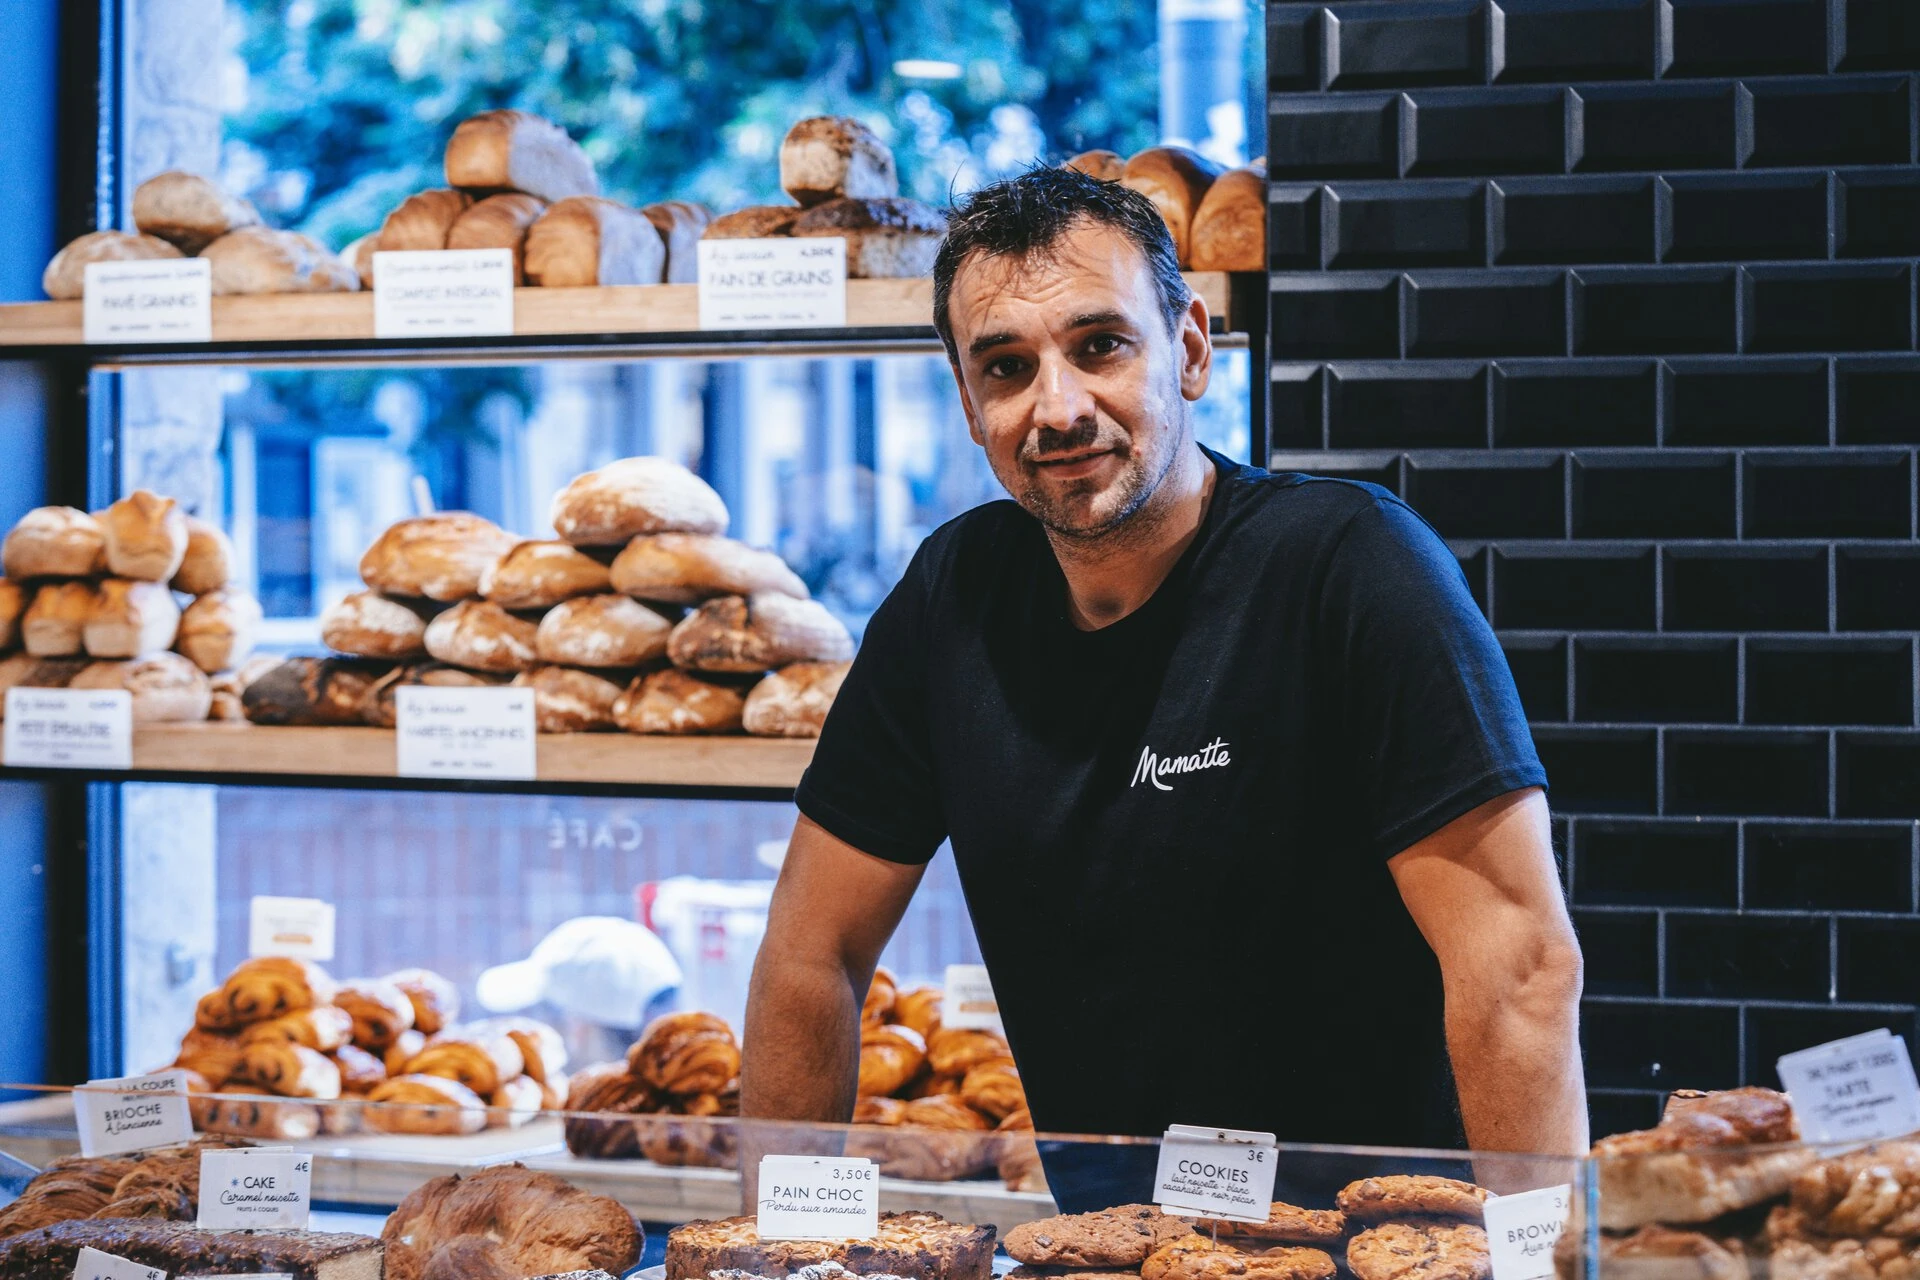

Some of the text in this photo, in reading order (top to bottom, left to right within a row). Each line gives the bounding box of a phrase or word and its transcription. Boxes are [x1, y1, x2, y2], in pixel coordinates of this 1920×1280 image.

[748, 271, 766, 287] DE
[771, 269, 834, 286] GRAINS
[1130, 737, 1231, 791] Mamatte
[141, 1078, 176, 1091] COUPE
[104, 1103, 162, 1122] BRIOCHE
[1247, 1149, 1265, 1163] 3€
[294, 1162, 309, 1172] 4€
[832, 1168, 872, 1181] 3,50€
[1178, 1160, 1249, 1184] COOKIES
[243, 1176, 276, 1189] CAKE
[1171, 1173, 1188, 1183] lait
[1187, 1178, 1220, 1190] noisette
[1226, 1182, 1250, 1195] blanc
[220, 1190, 301, 1205] Caramel noisette
[773, 1186, 864, 1202] PAIN CHOC
[760, 1199, 867, 1215] Perdu aux amandes
[1554, 1197, 1568, 1208] 3,
